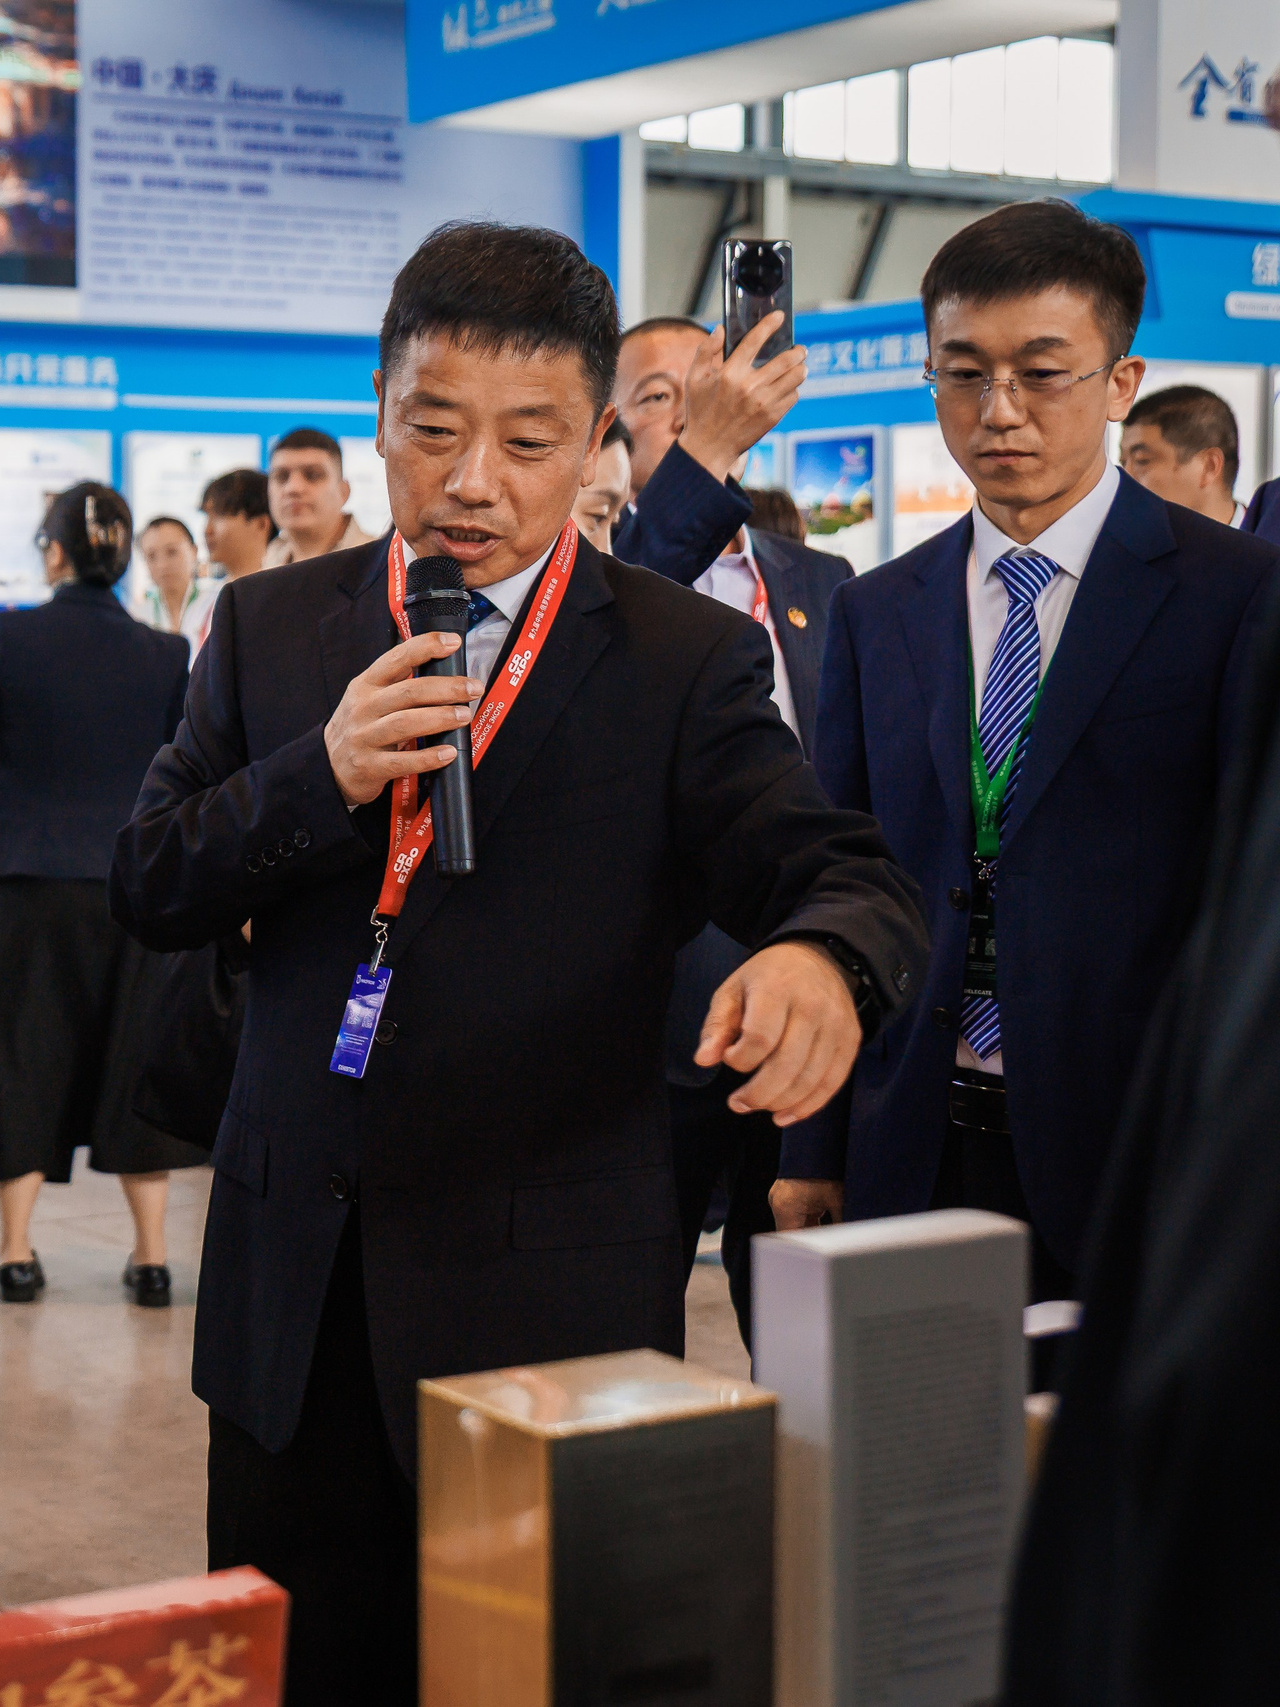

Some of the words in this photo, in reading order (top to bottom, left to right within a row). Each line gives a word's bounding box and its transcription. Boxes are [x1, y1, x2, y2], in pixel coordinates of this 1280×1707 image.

[509, 650, 532, 687] EXPO
[471, 702, 495, 742] ОССИЙСКО-
[472, 722, 492, 758] ИТАЙСКОЕ
[488, 701, 505, 724] ЭКСПО
[397, 847, 419, 884] EXPO
